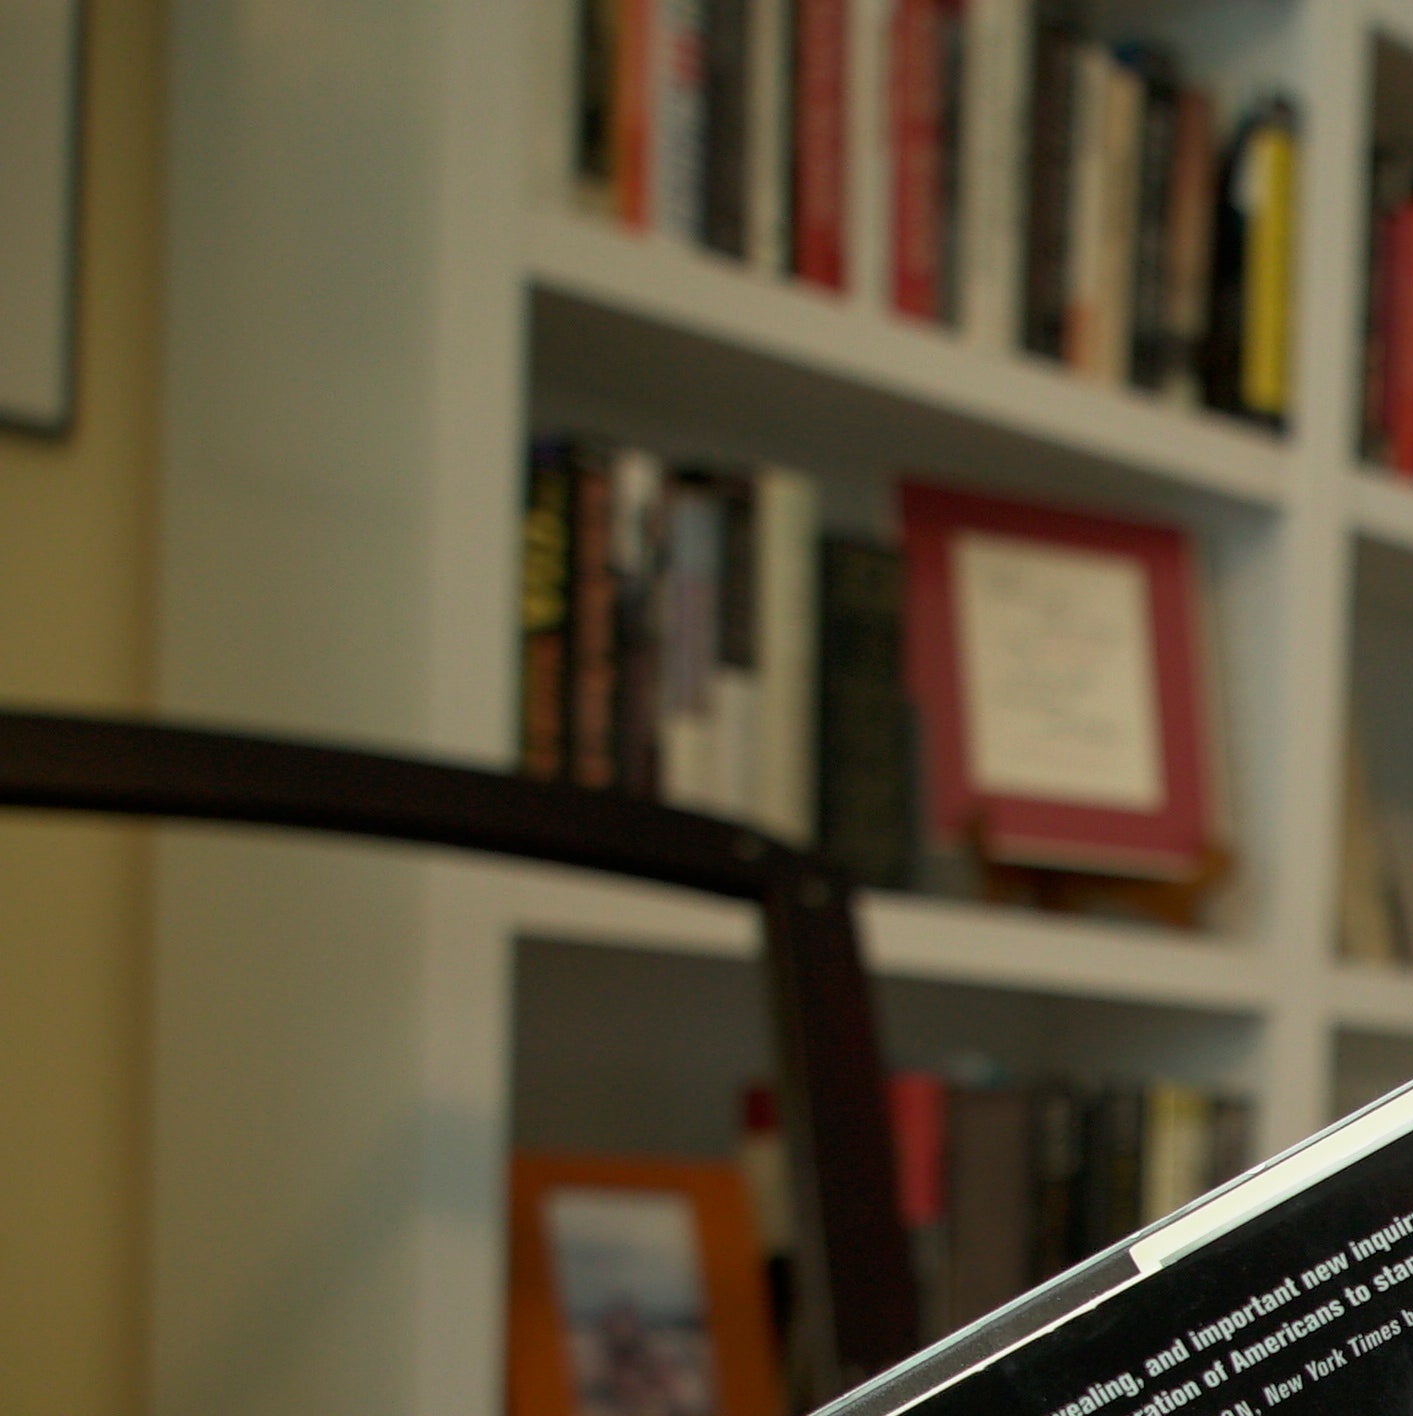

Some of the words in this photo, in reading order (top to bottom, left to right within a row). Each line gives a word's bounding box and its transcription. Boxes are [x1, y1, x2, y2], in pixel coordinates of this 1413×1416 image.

[1145, 1339, 1190, 1377] and
[1188, 1277, 1301, 1351] important
[1301, 1252, 1349, 1289] new
[1203, 1360, 1228, 1388] of
[1230, 1300, 1345, 1374] Americans
[1344, 1285, 1371, 1306] to
[1264, 1375, 1303, 1406] New
[1305, 1349, 1347, 1381] York
[1347, 1319, 1401, 1357] Times
